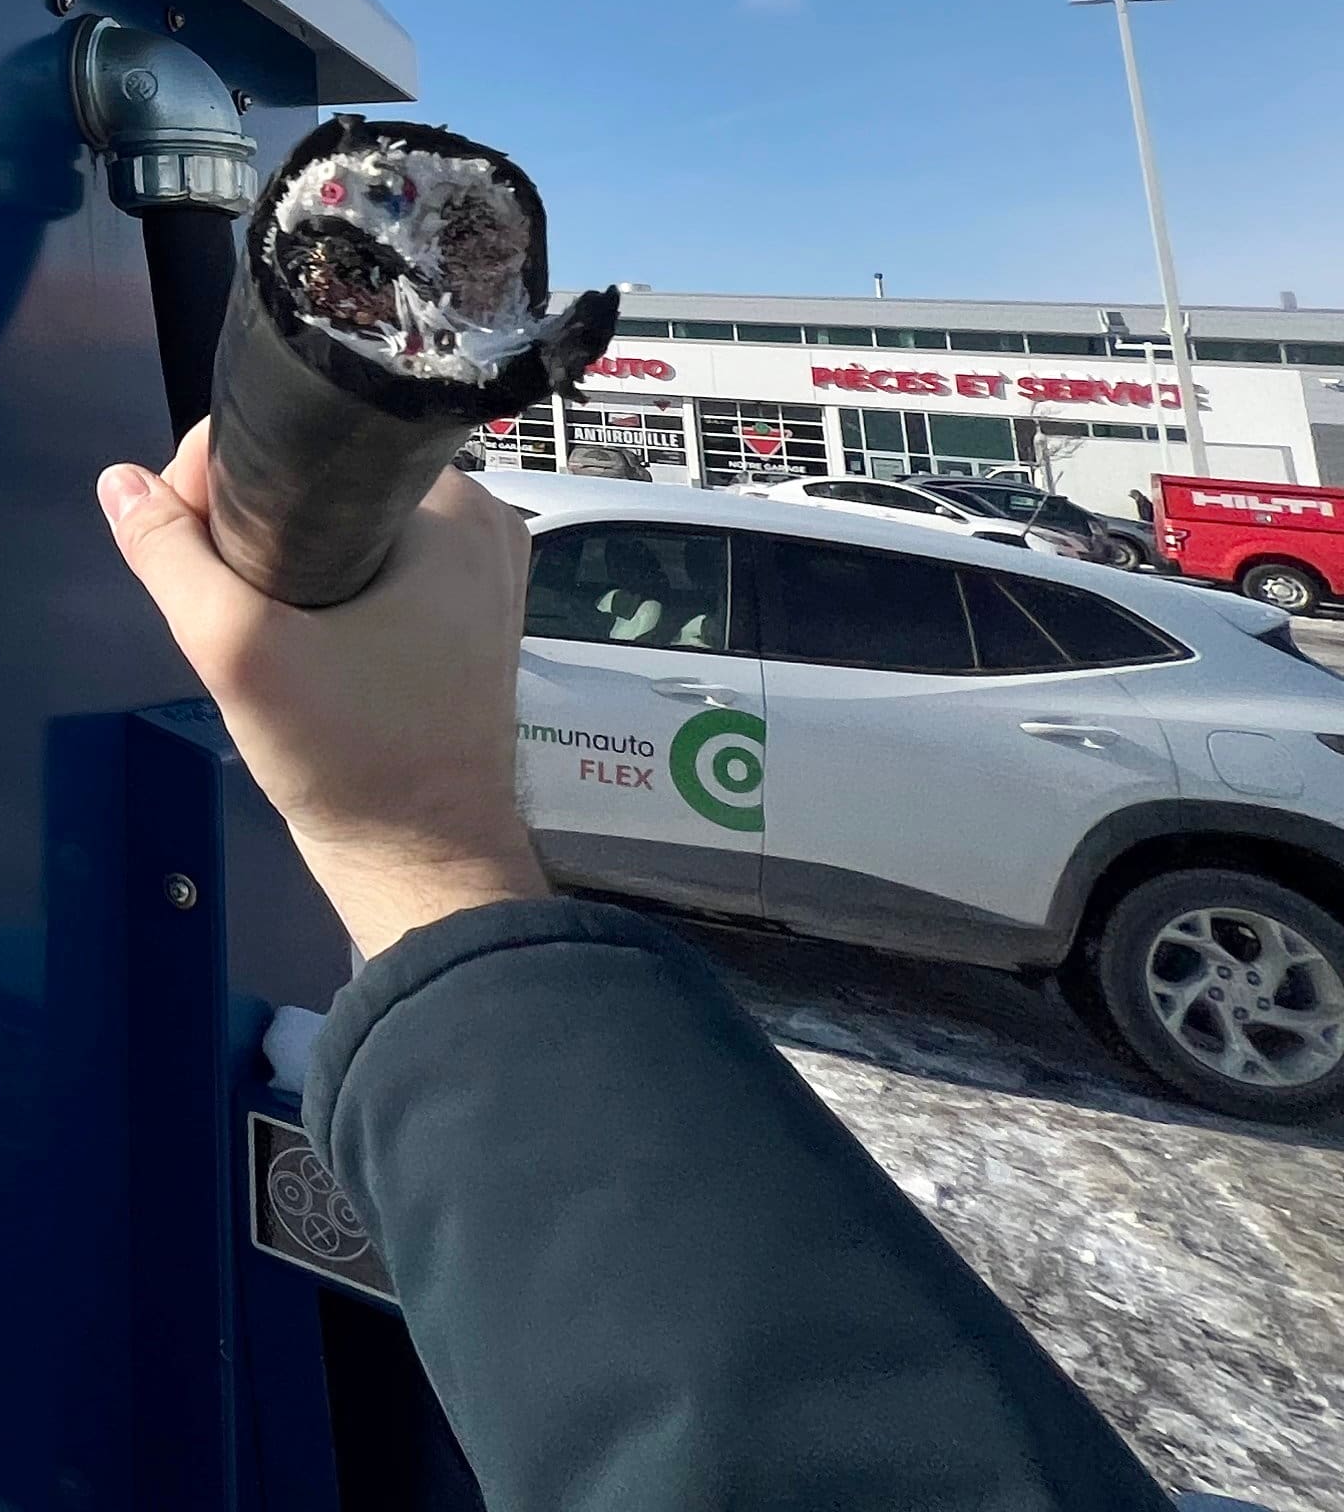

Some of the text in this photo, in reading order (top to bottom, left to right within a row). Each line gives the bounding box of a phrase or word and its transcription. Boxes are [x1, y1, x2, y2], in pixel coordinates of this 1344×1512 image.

[812, 362, 952, 396] PIÈCES
[956, 371, 1013, 400] ET
[573, 426, 679, 448] ANTIROUILLE
[728, 460, 762, 471] NOTRE
[1191, 490, 1335, 517] HILTI
[515, 722, 655, 758] mmunauto
[579, 757, 655, 791] FLEX
